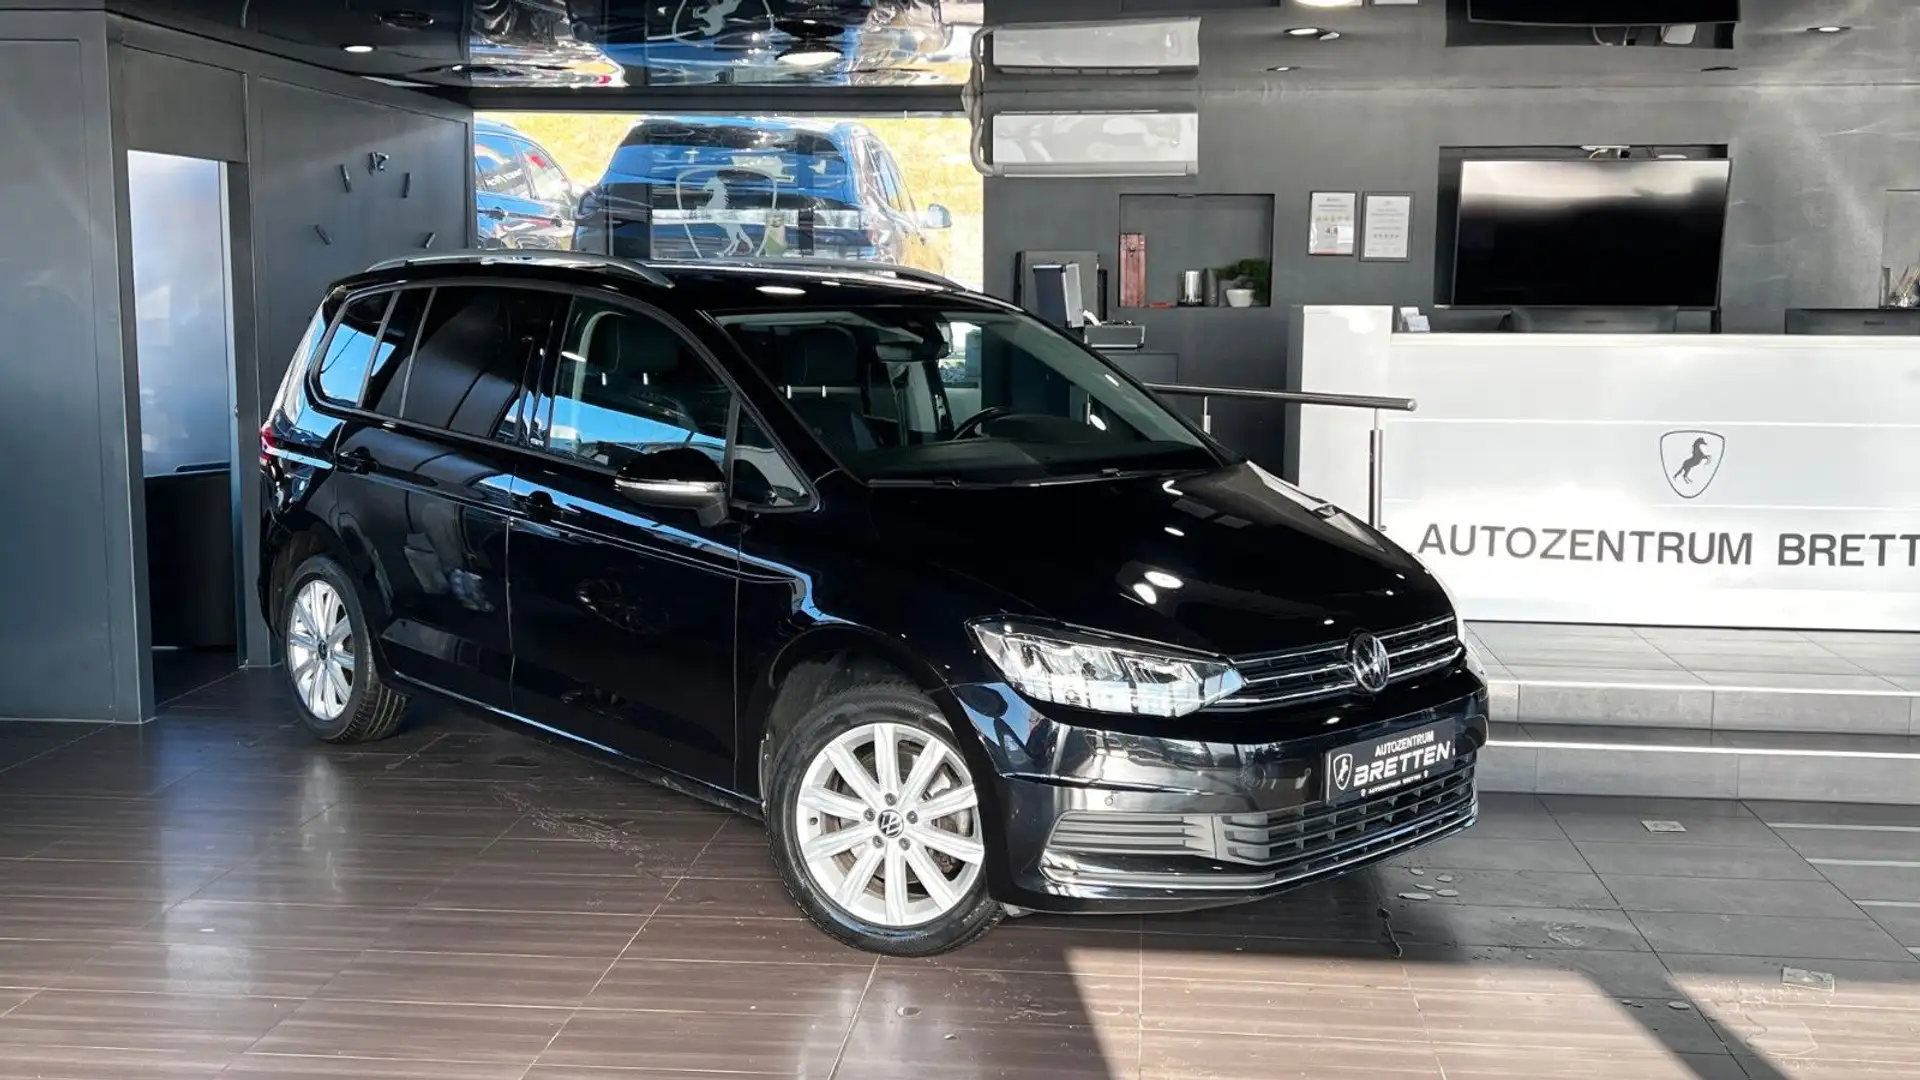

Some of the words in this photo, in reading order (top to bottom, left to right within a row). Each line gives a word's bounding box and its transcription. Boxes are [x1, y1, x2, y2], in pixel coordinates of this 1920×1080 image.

[1418, 524, 1753, 566] AUTOZENTRUM
[1778, 533, 1920, 567] BRETT
[1353, 740, 1451, 787] BRETTEN
[1375, 730, 1434, 758] AUTOZENTRUM
